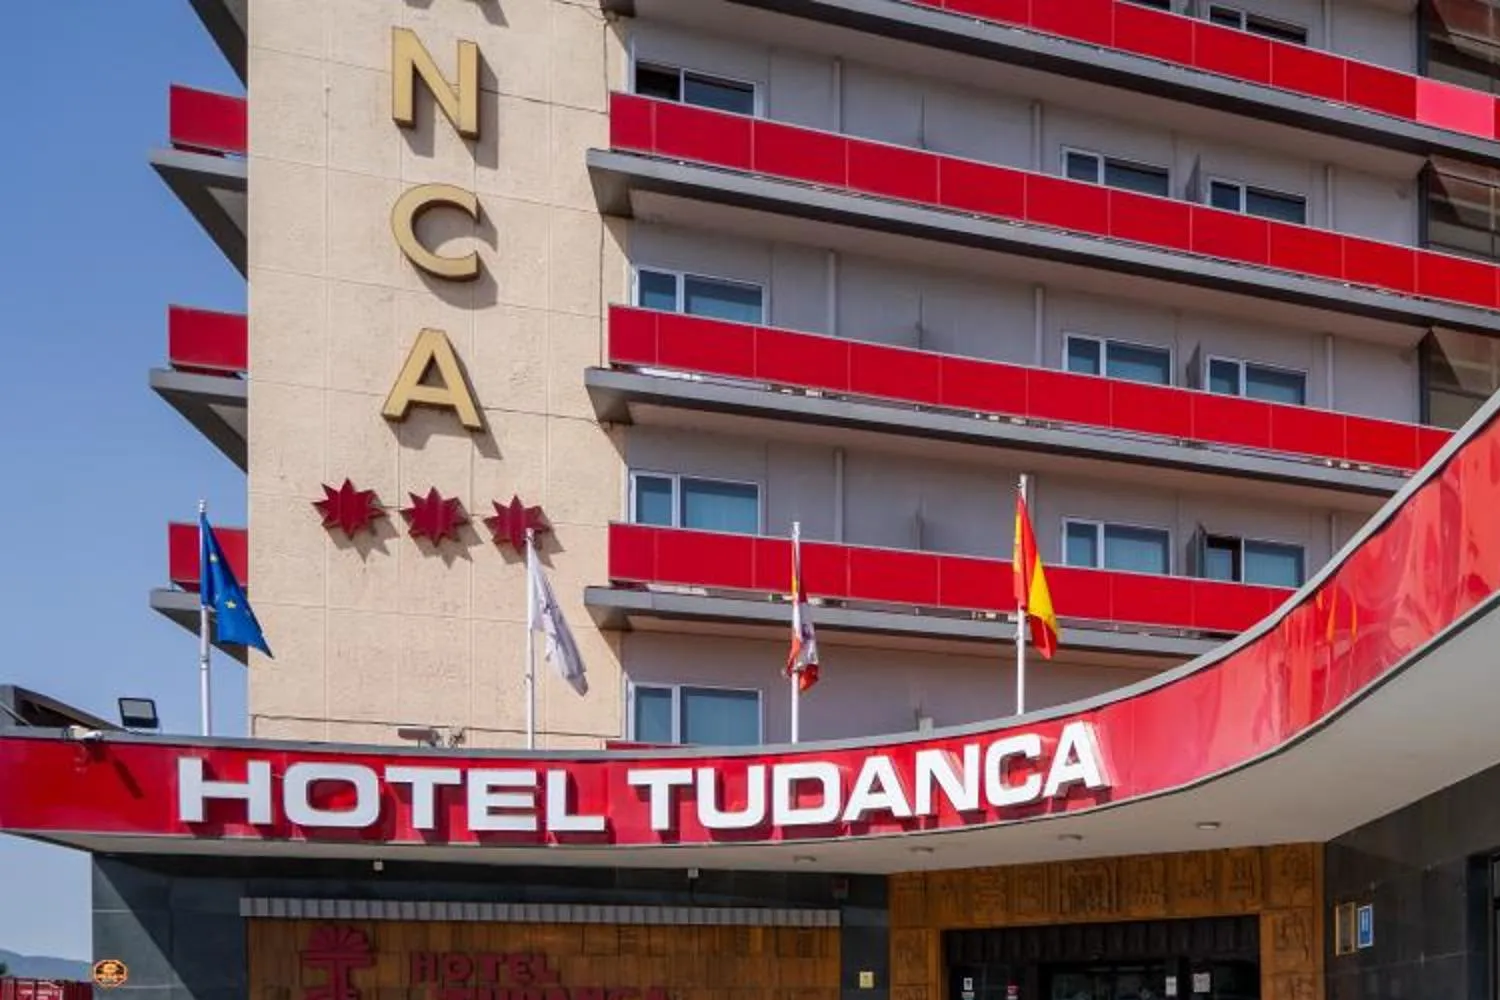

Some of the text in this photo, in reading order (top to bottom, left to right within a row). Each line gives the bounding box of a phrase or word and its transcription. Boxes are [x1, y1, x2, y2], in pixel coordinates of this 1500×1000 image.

[177, 720, 1106, 831] HOTEL TUDANCA
[410, 951, 560, 986] HOTEL
